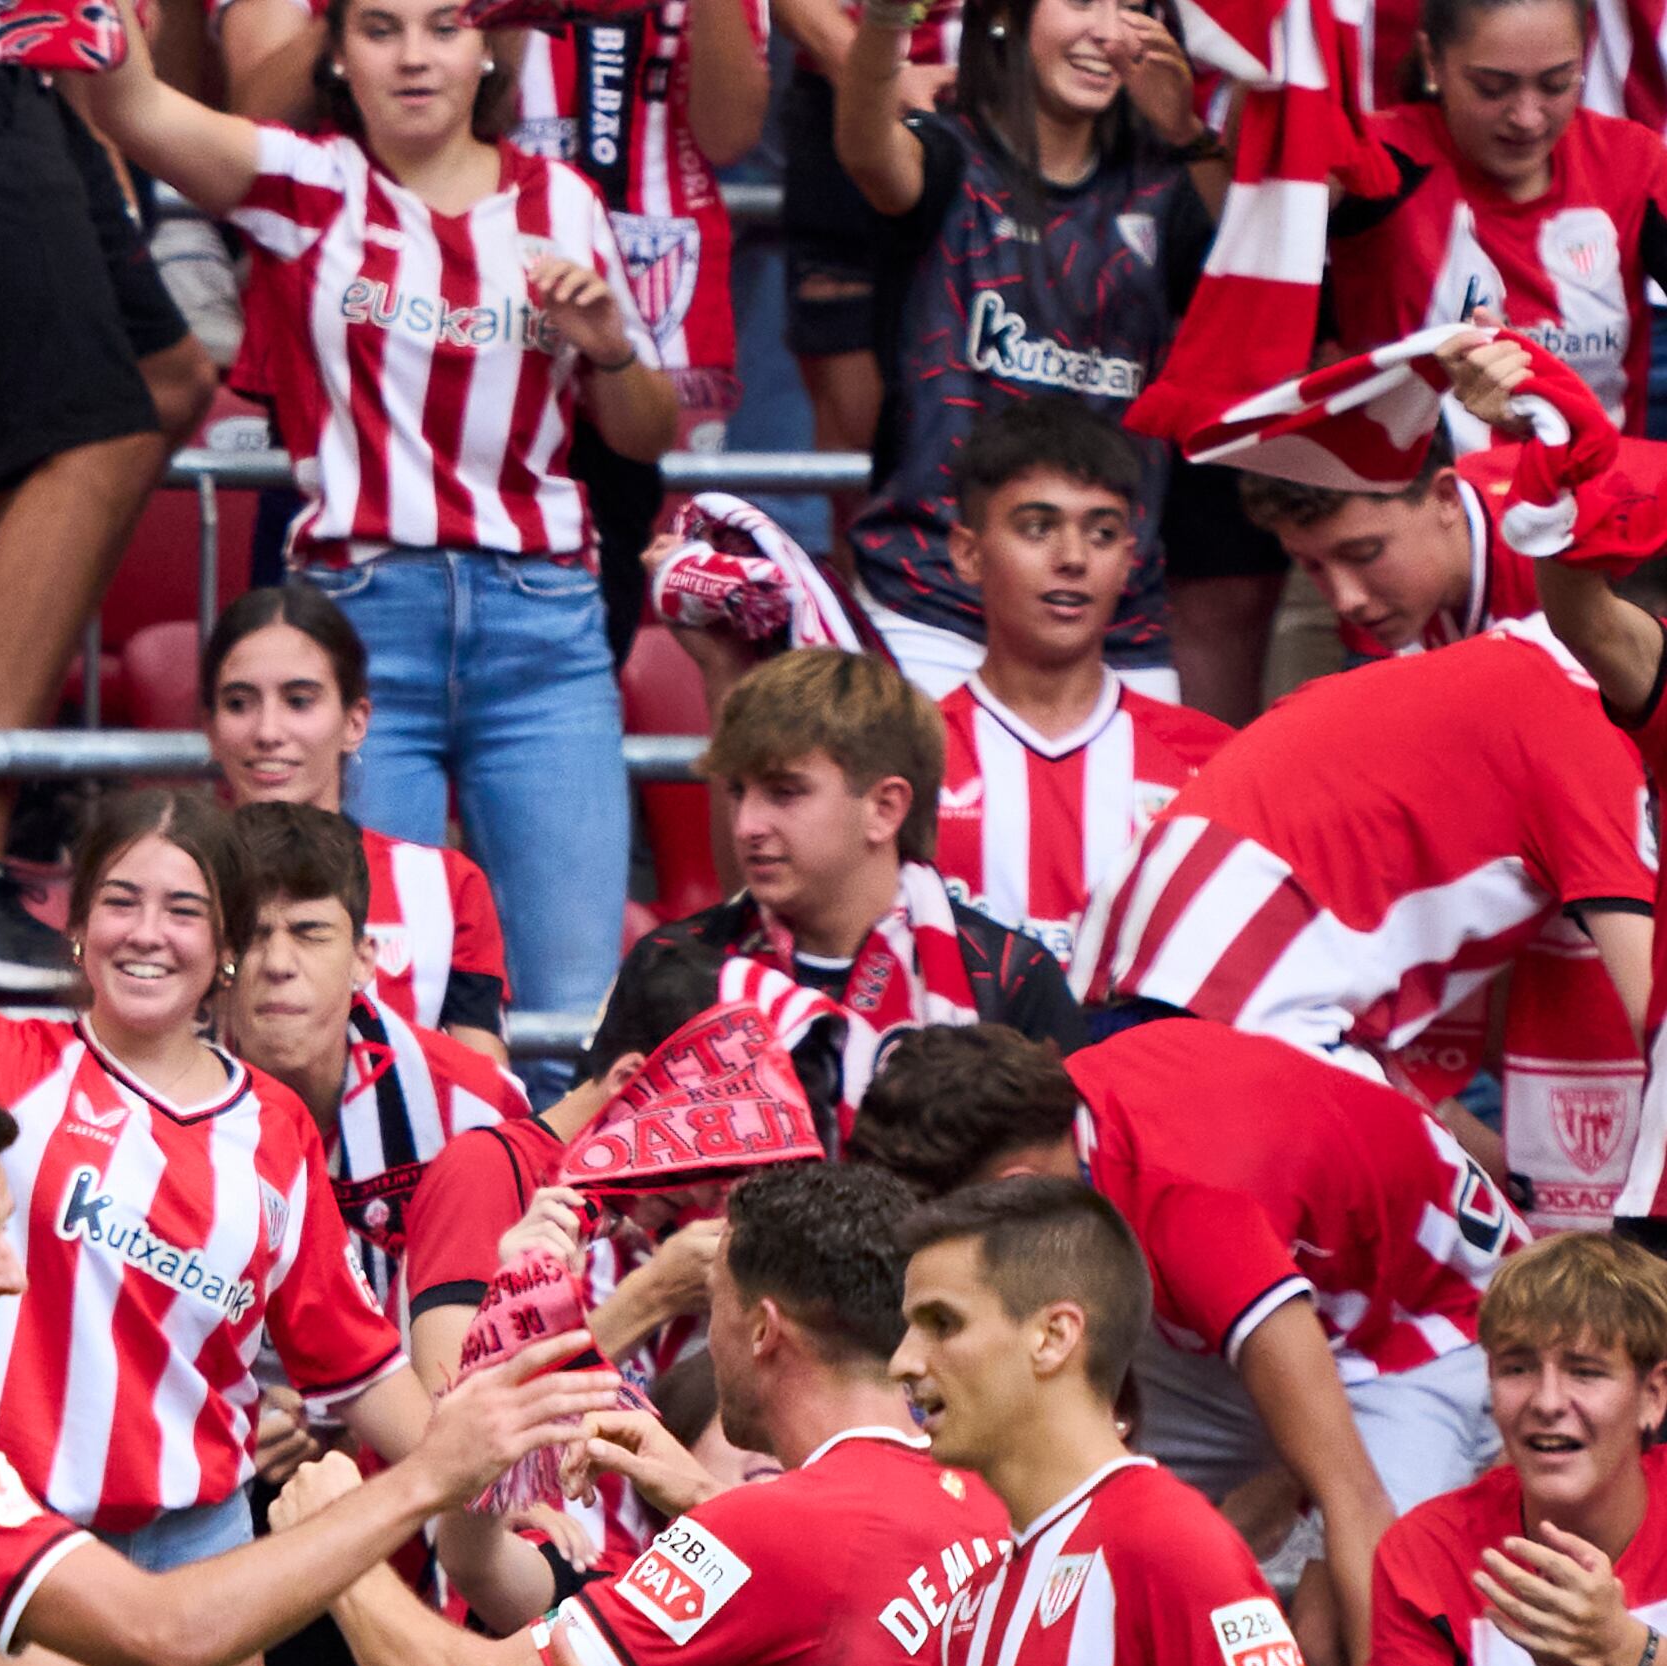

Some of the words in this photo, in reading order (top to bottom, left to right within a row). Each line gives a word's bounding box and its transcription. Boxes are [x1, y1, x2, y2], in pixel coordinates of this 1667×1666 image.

[342, 277, 561, 353] euskalte
[64, 1170, 255, 1322] Kutxabank
[636, 1556, 692, 1605] PAY
